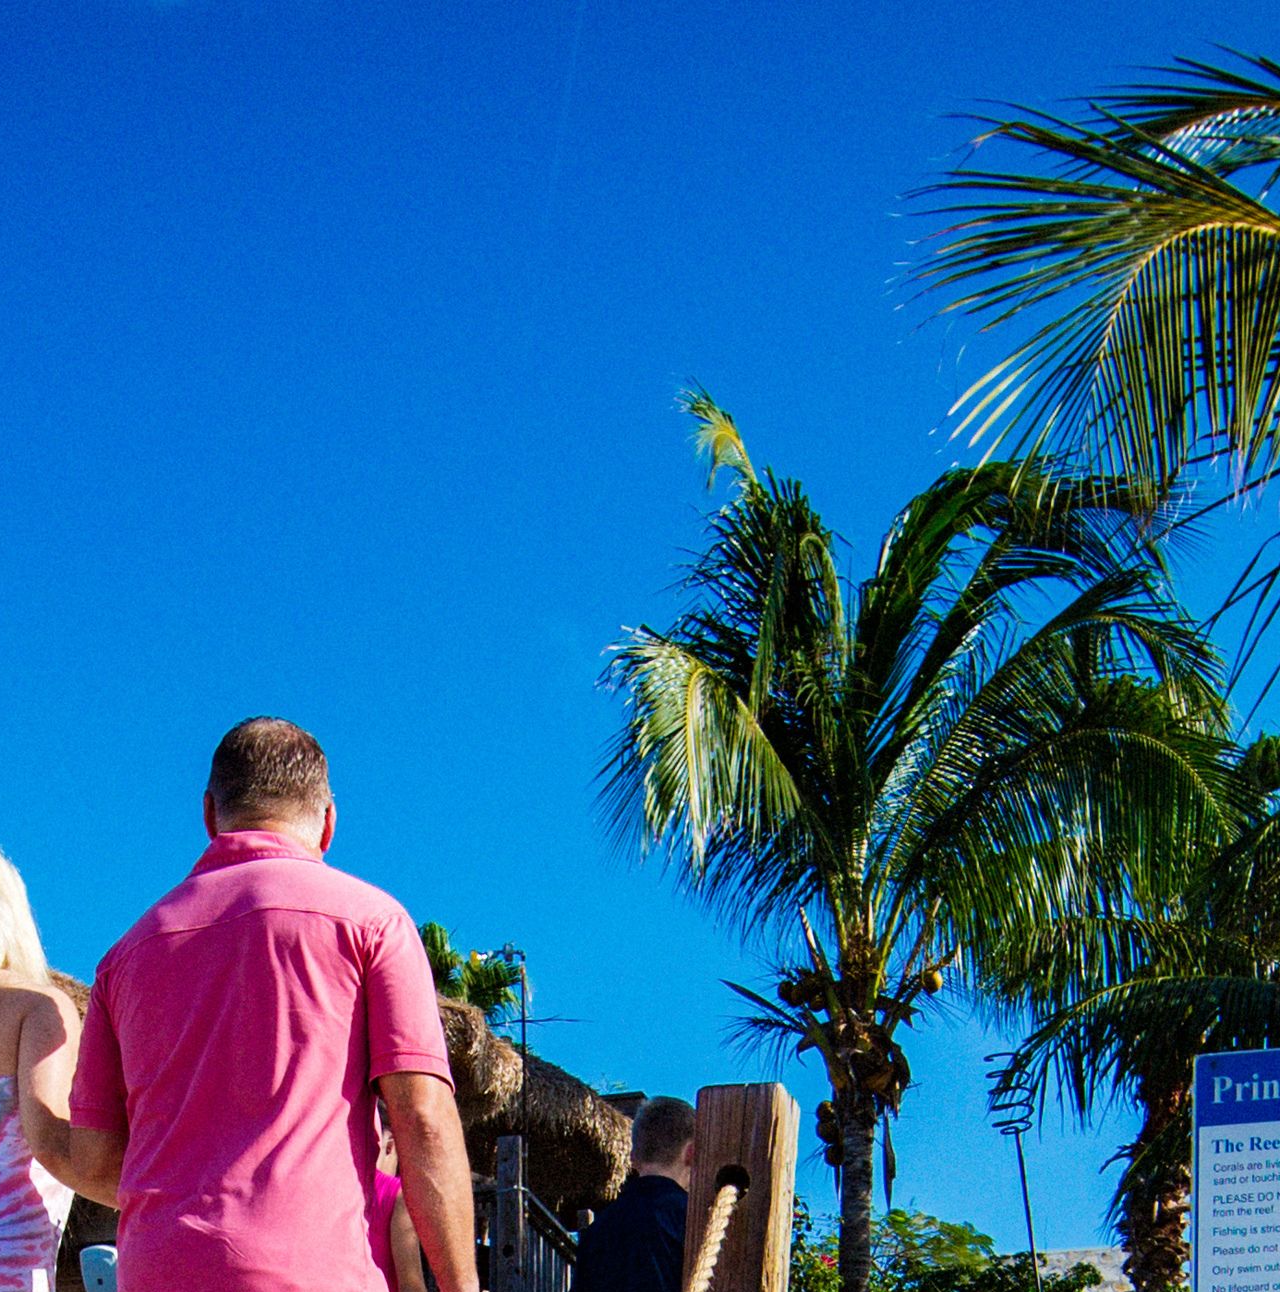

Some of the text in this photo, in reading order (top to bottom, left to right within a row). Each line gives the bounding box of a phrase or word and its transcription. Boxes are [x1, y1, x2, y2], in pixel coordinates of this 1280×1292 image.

[1211, 1138, 1244, 1155] The
[1213, 1194, 1255, 1204] PLEASE
[1258, 1192, 1273, 1201] DO
[1213, 1225, 1247, 1238] Fishing
[1250, 1226, 1258, 1235] is
[1213, 1246, 1245, 1256] Please
[1248, 1245, 1260, 1253] do
[1263, 1244, 1278, 1253] not
[1213, 1264, 1234, 1277] Only
[1238, 1264, 1262, 1274] swim
